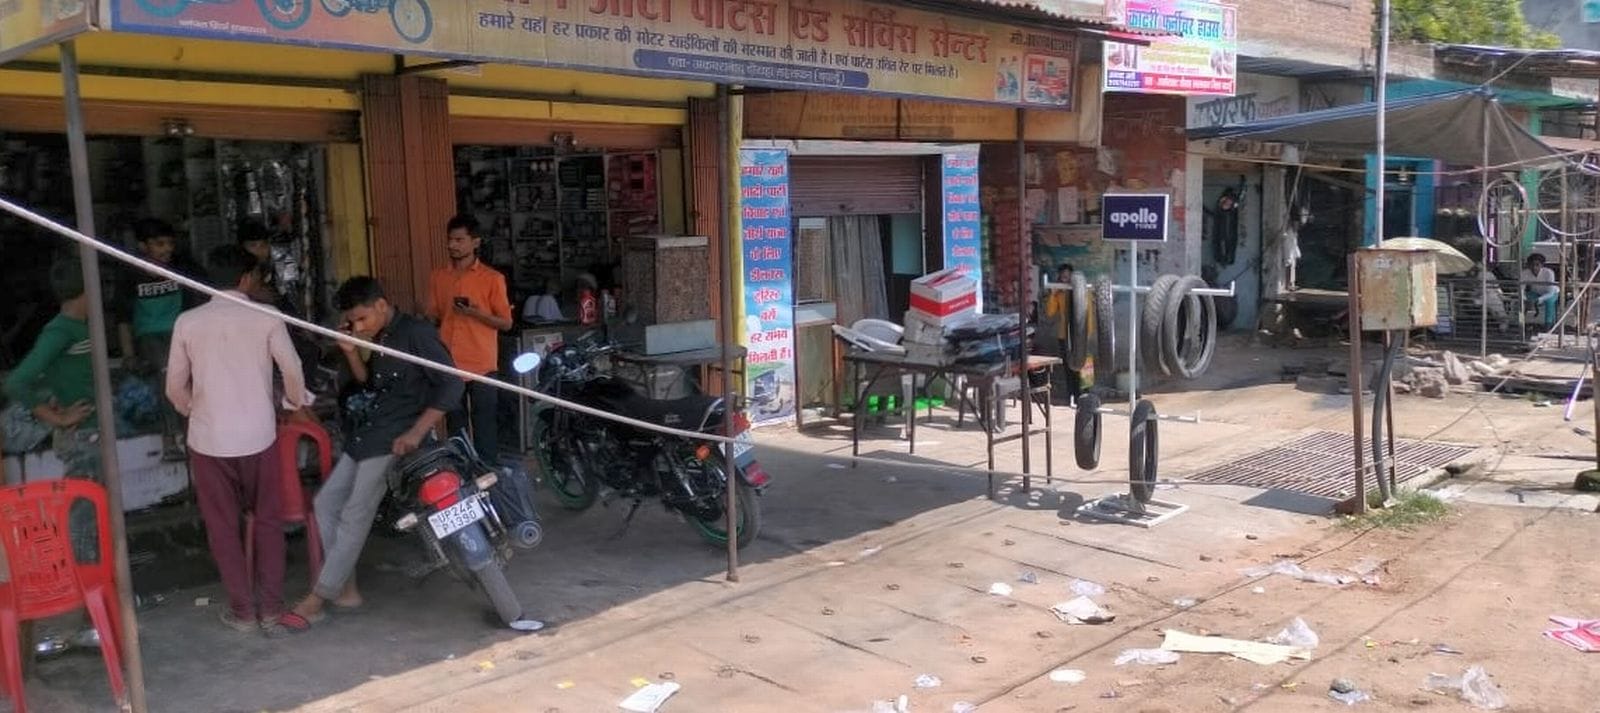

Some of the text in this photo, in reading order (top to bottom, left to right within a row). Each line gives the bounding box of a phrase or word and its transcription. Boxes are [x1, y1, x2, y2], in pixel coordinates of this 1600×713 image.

[479, 11, 515, 29] हमारे
[551, 22, 570, 37] हर
[575, 24, 611, 42] प्रकार
[614, 25, 631, 43] की
[637, 27, 665, 47] मोटर
[723, 38, 739, 55] की
[779, 43, 793, 61] की
[797, 46, 817, 63] जाती
[875, 57, 897, 74] उचित
[899, 58, 910, 73] रेट
[912, 62, 923, 74] पर
[842, 7, 919, 55] सर्विस
[928, 17, 991, 64] सेन्टर
[1110, 207, 1158, 228] apollo
[750, 329, 788, 344] हर समय
